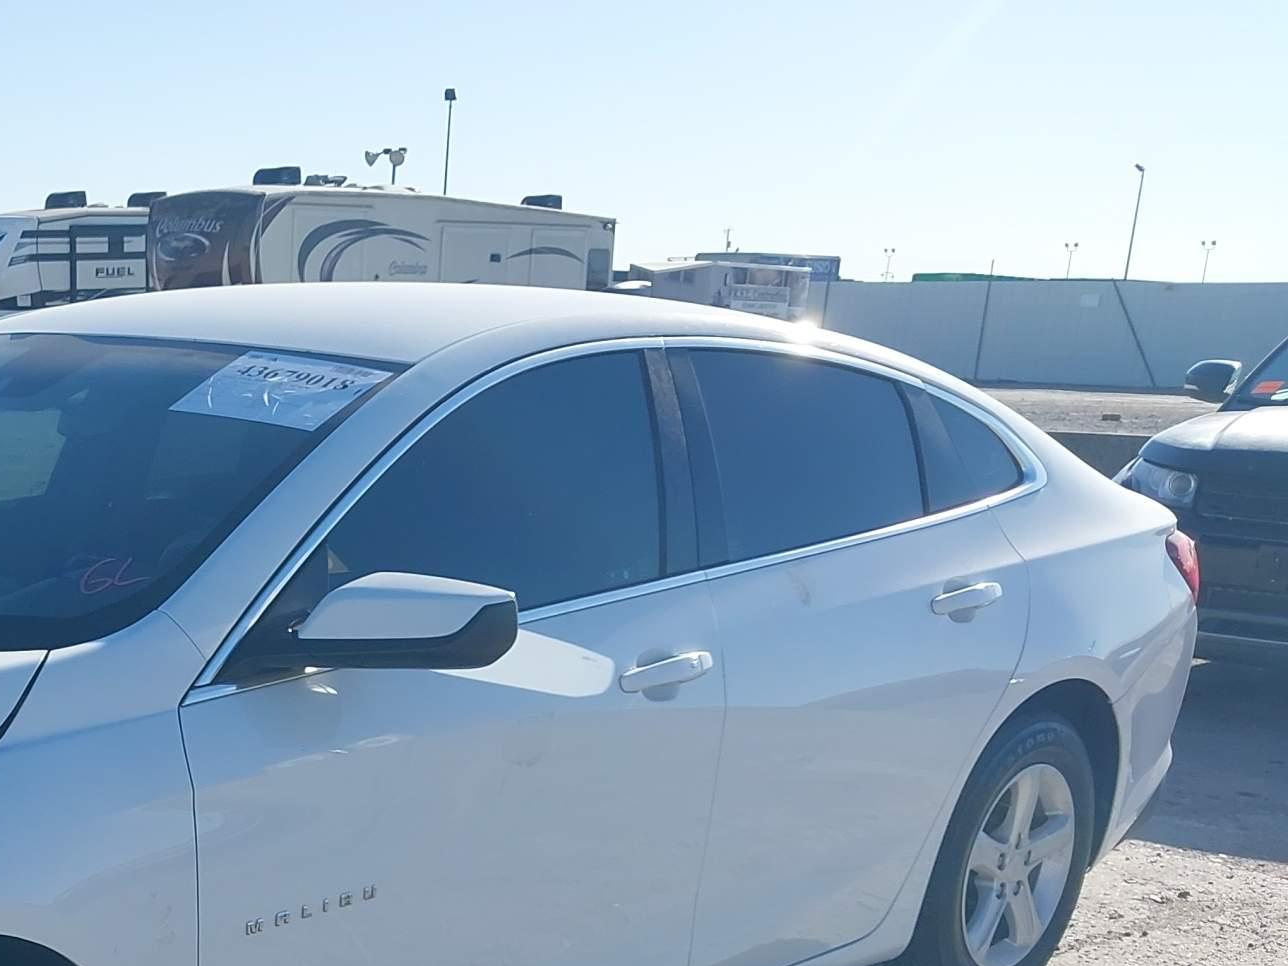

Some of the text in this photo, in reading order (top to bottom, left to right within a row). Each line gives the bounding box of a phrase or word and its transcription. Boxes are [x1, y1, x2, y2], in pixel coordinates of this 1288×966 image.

[95, 267, 134, 277] FUEL
[237, 364, 356, 391] 43679018
[245, 884, 377, 936] MALIBU
